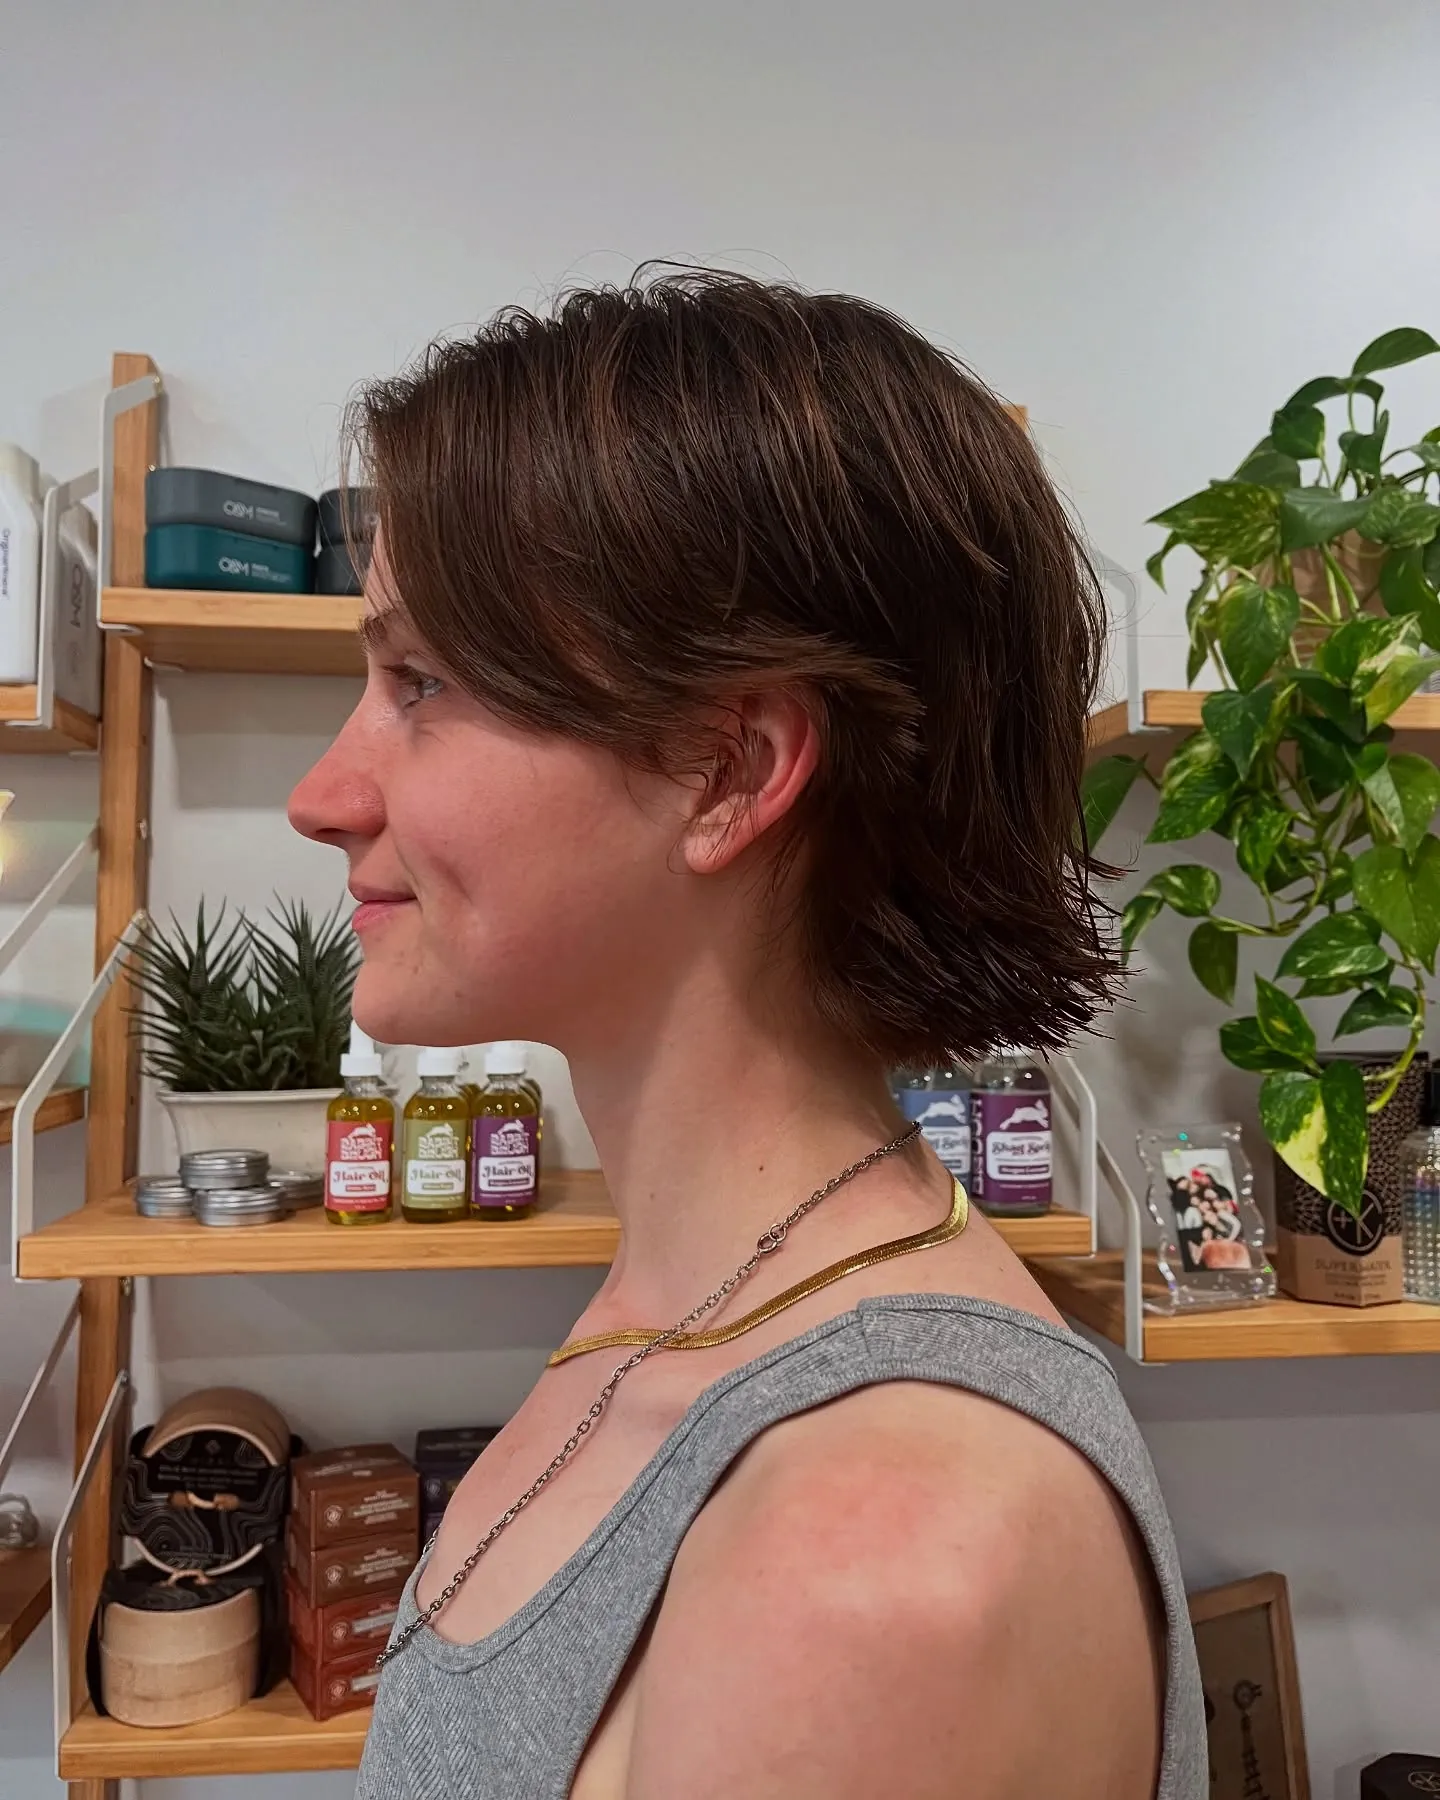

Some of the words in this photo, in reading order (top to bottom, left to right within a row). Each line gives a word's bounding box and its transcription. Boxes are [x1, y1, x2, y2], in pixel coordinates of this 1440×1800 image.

[333, 1171, 366, 1182] Hair
[369, 1170, 389, 1183] Oil
[410, 1168, 443, 1180] Hair
[445, 1168, 464, 1182] Oil
[482, 1166, 516, 1178] Hair
[518, 1165, 535, 1178] Oil
